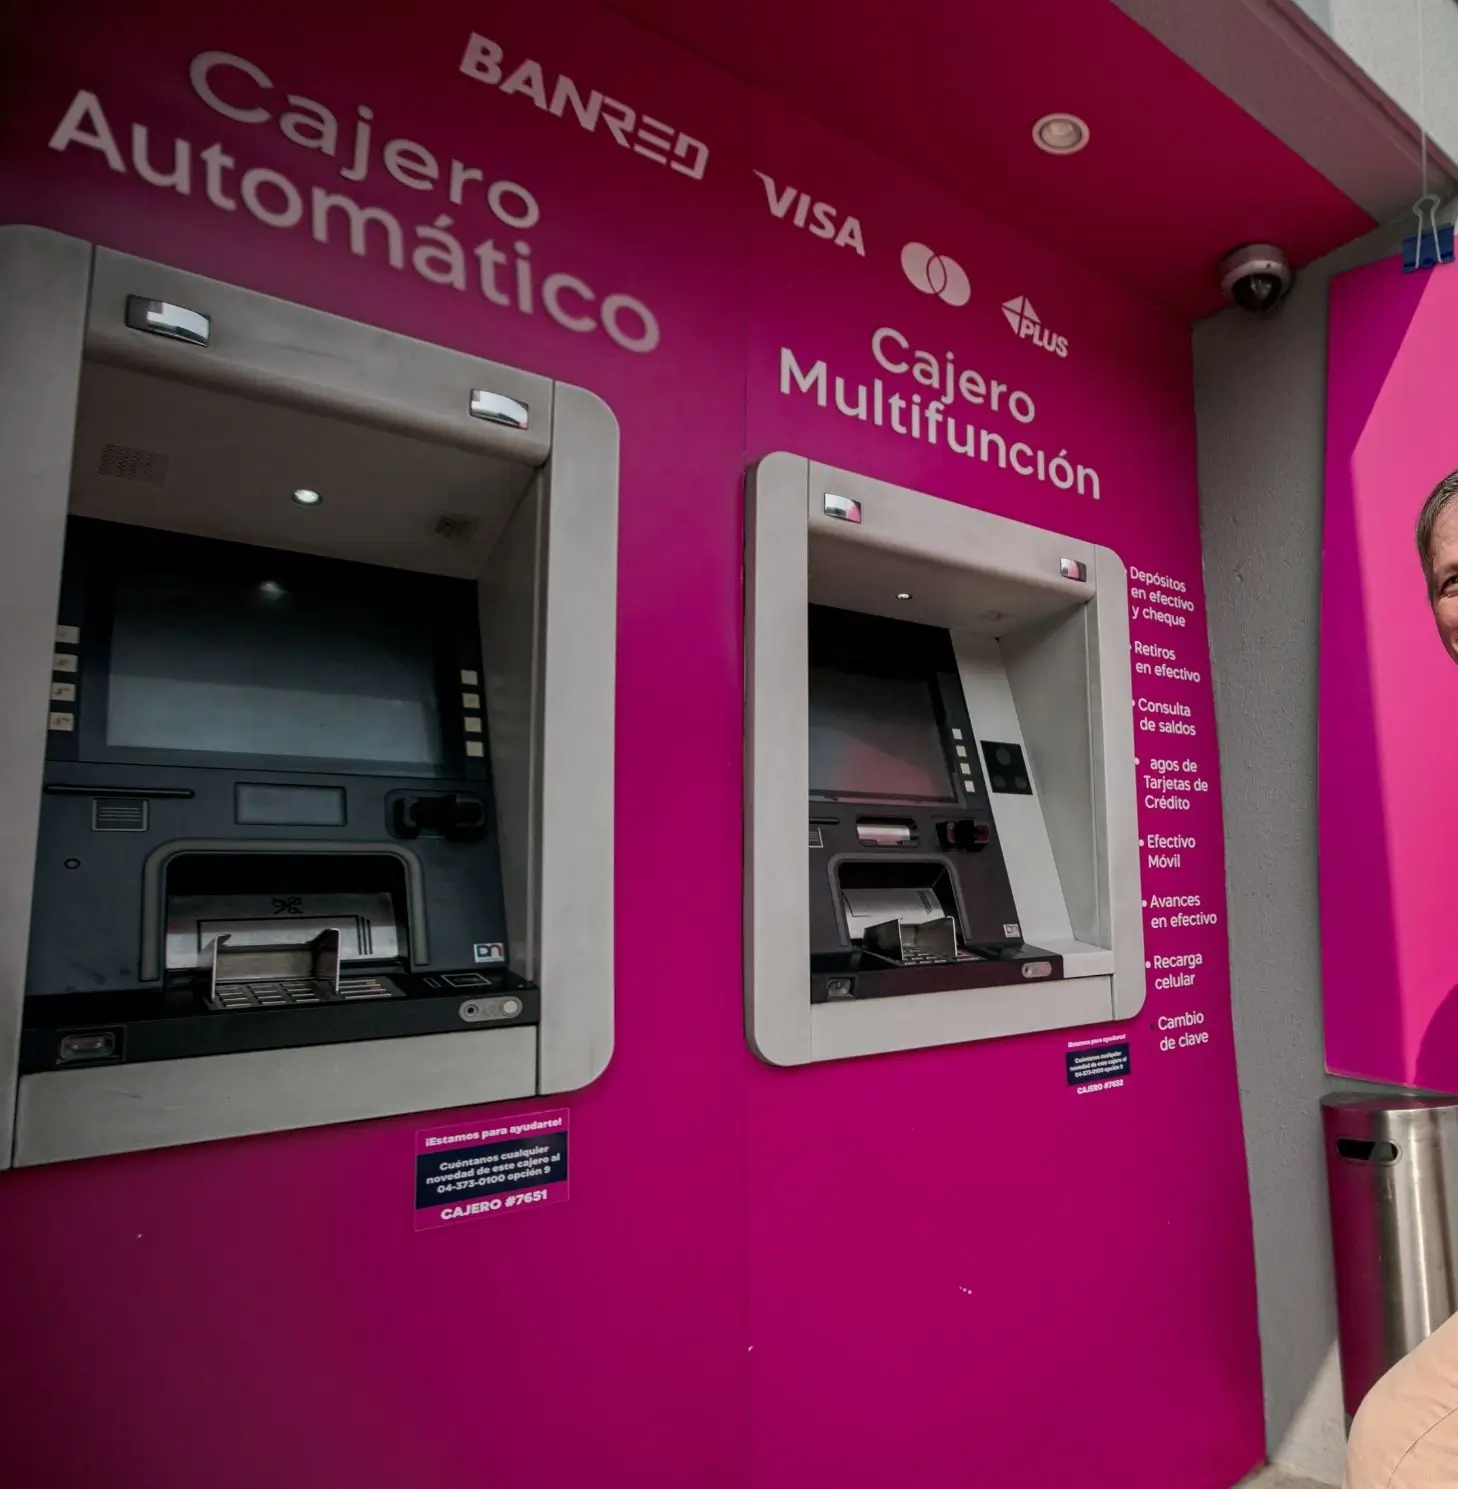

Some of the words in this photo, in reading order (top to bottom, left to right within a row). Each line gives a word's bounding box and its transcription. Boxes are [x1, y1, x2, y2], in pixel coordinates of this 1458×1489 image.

[459, 31, 709, 180] BANRED
[189, 50, 539, 229] Cajero
[48, 89, 660, 353] Automático
[753, 169, 866, 257] VISA
[1019, 320, 1069, 358] PLUS
[871, 327, 1036, 424] Cajero
[779, 346, 1100, 500] Multifunción
[1130, 566, 1186, 592] Depósitos
[1131, 588, 1146, 599] en
[1149, 591, 1194, 612] efectivo
[1132, 606, 1139, 619] y
[1143, 608, 1186, 627] cheque
[1135, 640, 1176, 660] Retiros
[1136, 663, 1151, 674] en
[1155, 663, 1200, 682] efectivo
[1138, 698, 1191, 717] Consulta
[1140, 718, 1155, 731] de
[1159, 718, 1196, 736] saldos
[1183, 759, 1197, 772] de
[1144, 775, 1191, 793] Tarjetas
[1194, 778, 1208, 791] de
[1145, 795, 1190, 810] Crédito
[1148, 835, 1196, 849] Efectivo
[1149, 854, 1181, 868] Móvil
[1150, 894, 1200, 909] Avances
[1151, 917, 1167, 928] en
[1171, 912, 1217, 927] efectivo
[1154, 953, 1203, 970] Recarga
[1155, 973, 1195, 990] celular
[1158, 1011, 1204, 1031] Cambio
[1160, 1037, 1176, 1052] de
[1179, 1031, 1209, 1048] clave
[482, 1127, 508, 1140] para
[510, 1118, 562, 1134] ayudarte!
[426, 1169, 475, 1184] novedad
[477, 1165, 490, 1176] de
[492, 1164, 515, 1173] este
[517, 1156, 549, 1170] cajero
[551, 1153, 561, 1162] al
[439, 1154, 499, 1171] Cuéntanos
[501, 1146, 549, 1160] cualquier
[437, 1174, 506, 1194] 04-373-0100
[508, 1167, 542, 1182] opción
[544, 1166, 551, 1174] 9
[441, 1199, 502, 1220] CAJERO
[505, 1189, 548, 1208] #7651
